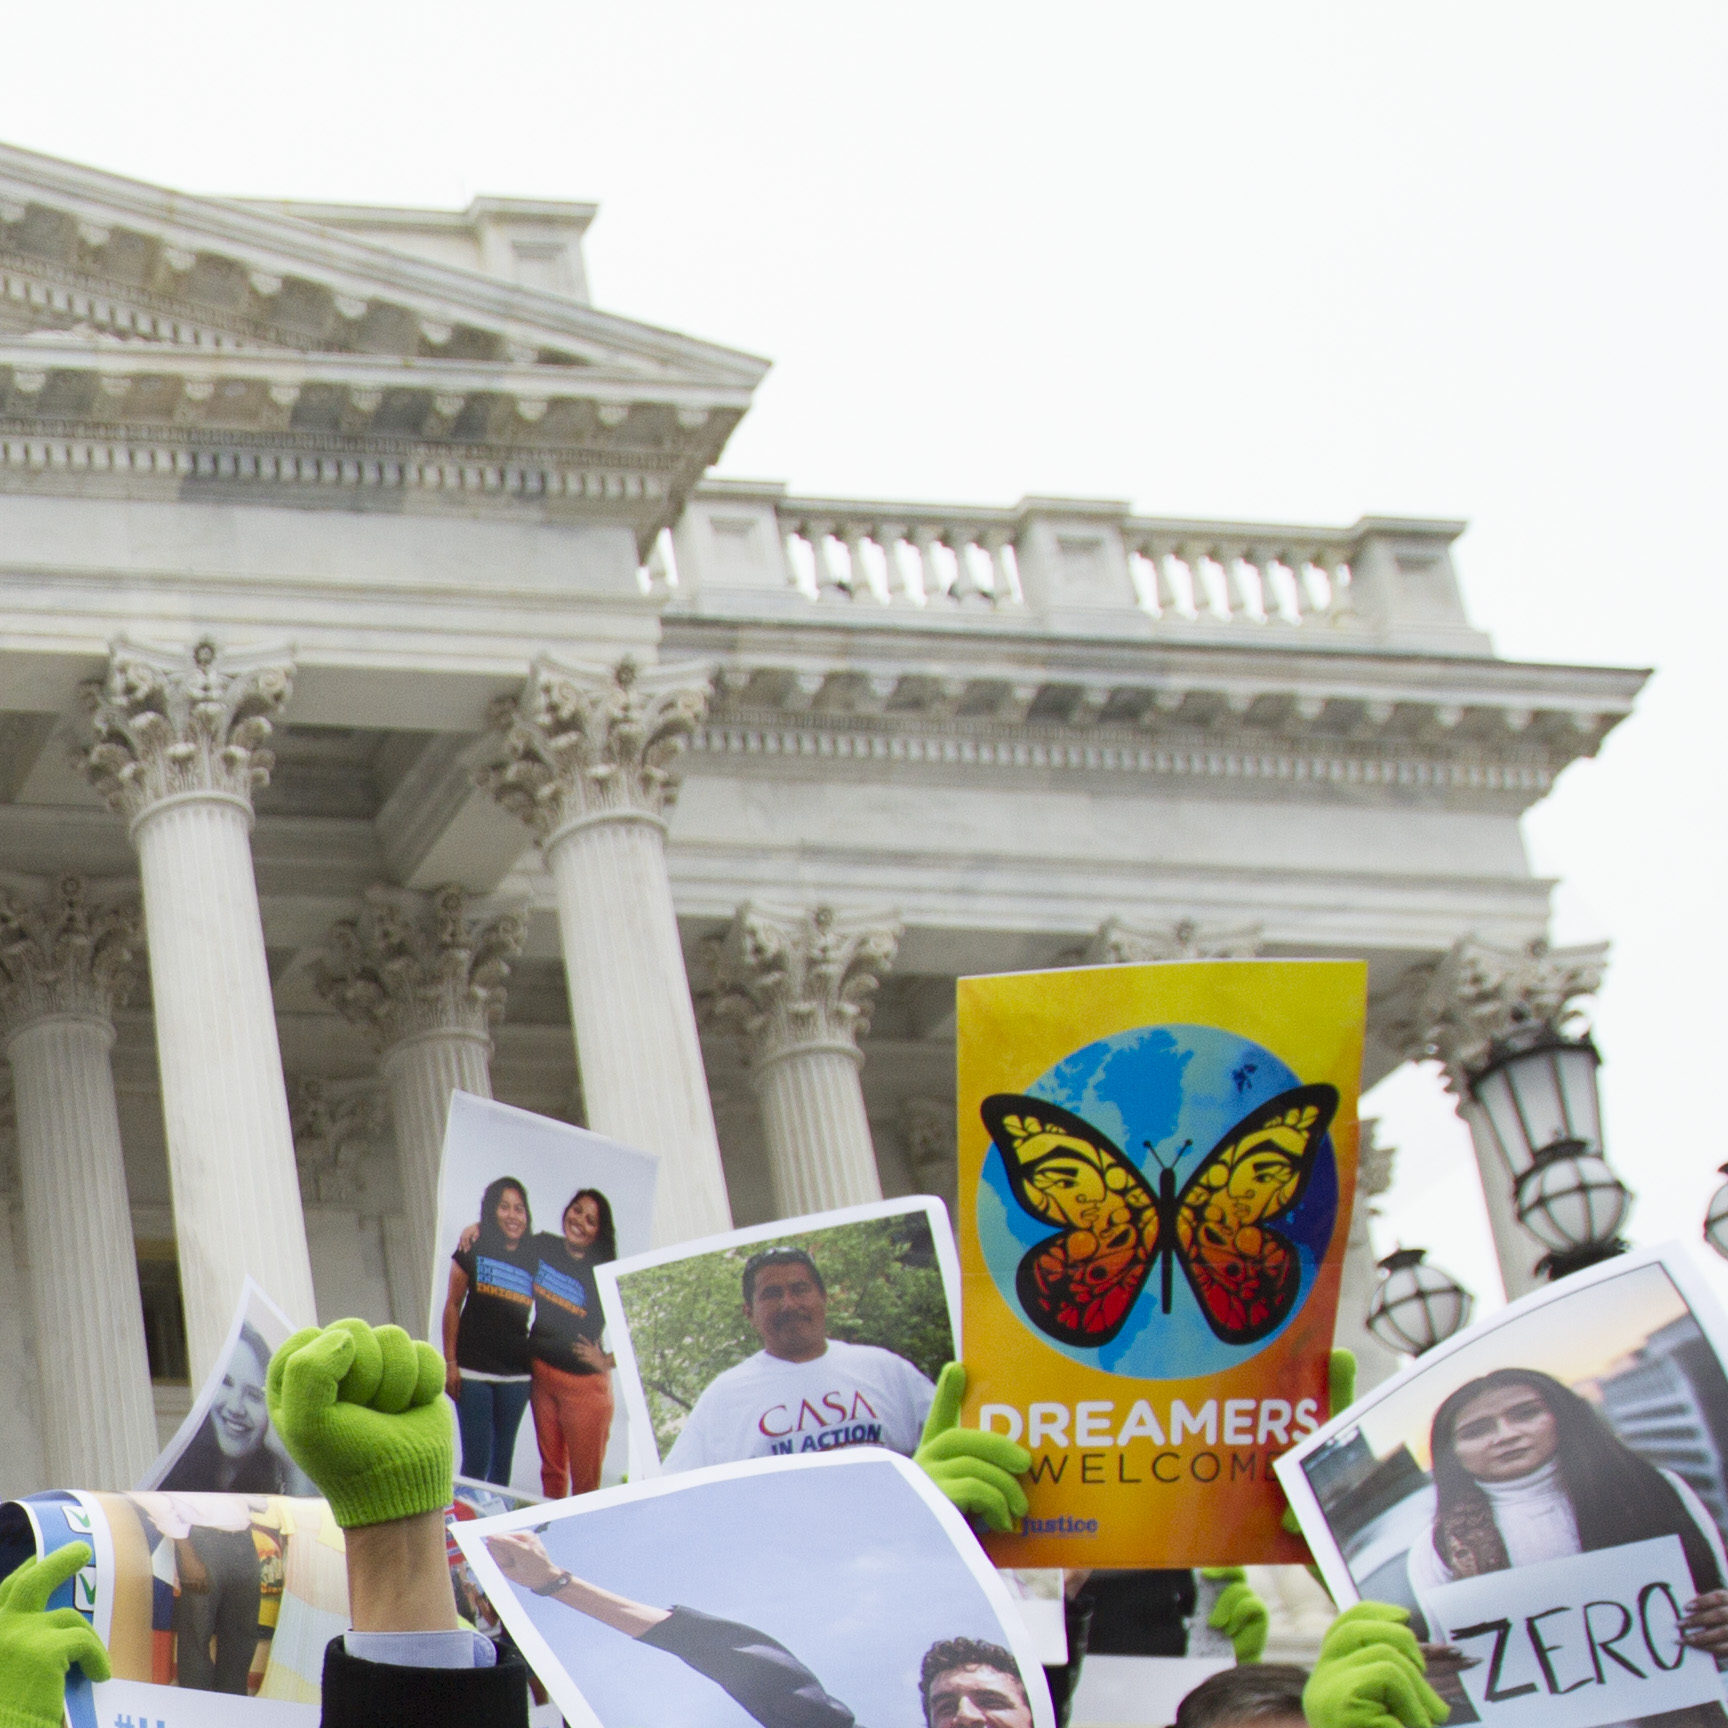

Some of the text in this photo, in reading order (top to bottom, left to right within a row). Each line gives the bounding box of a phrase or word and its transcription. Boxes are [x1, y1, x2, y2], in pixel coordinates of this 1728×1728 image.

[758, 1390, 878, 1438] CASA
[979, 1398, 1320, 1449] DREAMERS
[771, 1423, 882, 1456] IN ACTION
[1021, 1515, 1099, 1537] justice
[1449, 1581, 1688, 1704] ZERO
